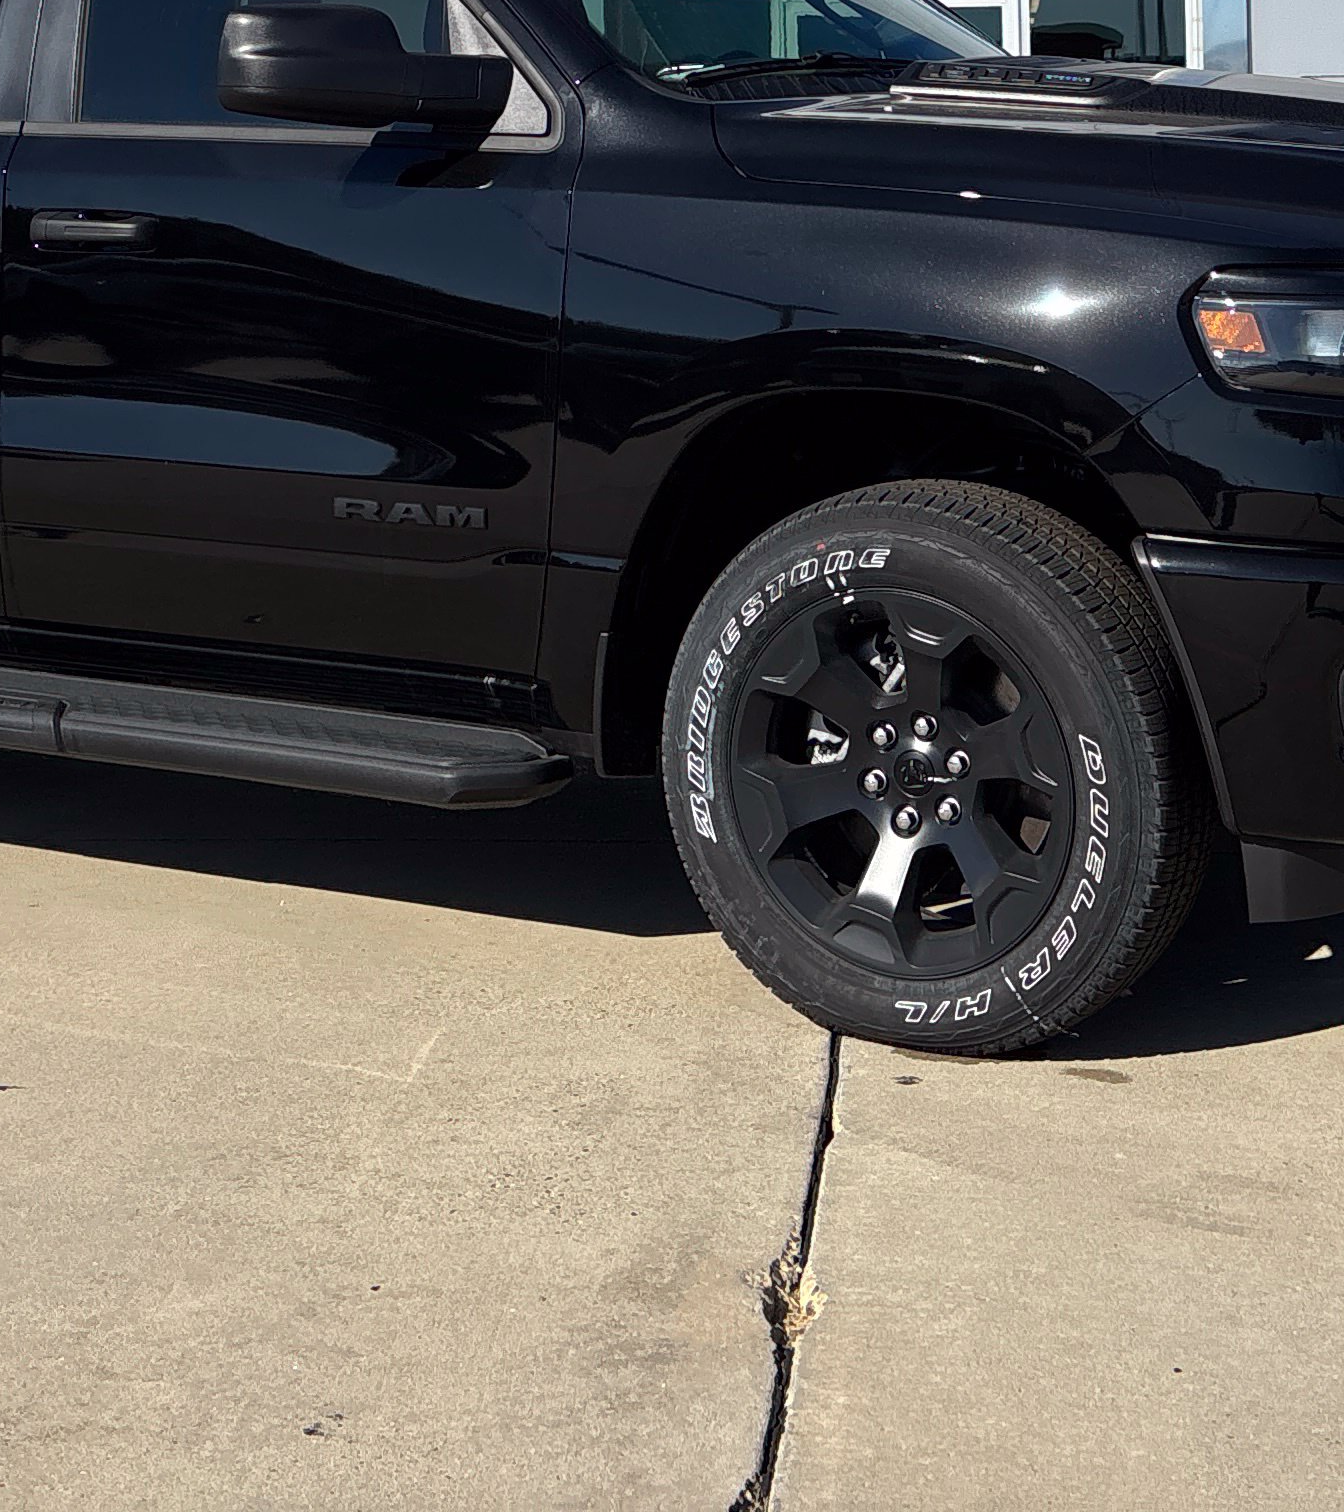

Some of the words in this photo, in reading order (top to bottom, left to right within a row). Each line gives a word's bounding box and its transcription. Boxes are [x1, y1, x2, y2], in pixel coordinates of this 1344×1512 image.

[333, 496, 488, 530] RAM
[686, 547, 891, 844] BRIDGESTONE
[1018, 733, 1110, 992] DUELER
[894, 987, 993, 1025] H/L
